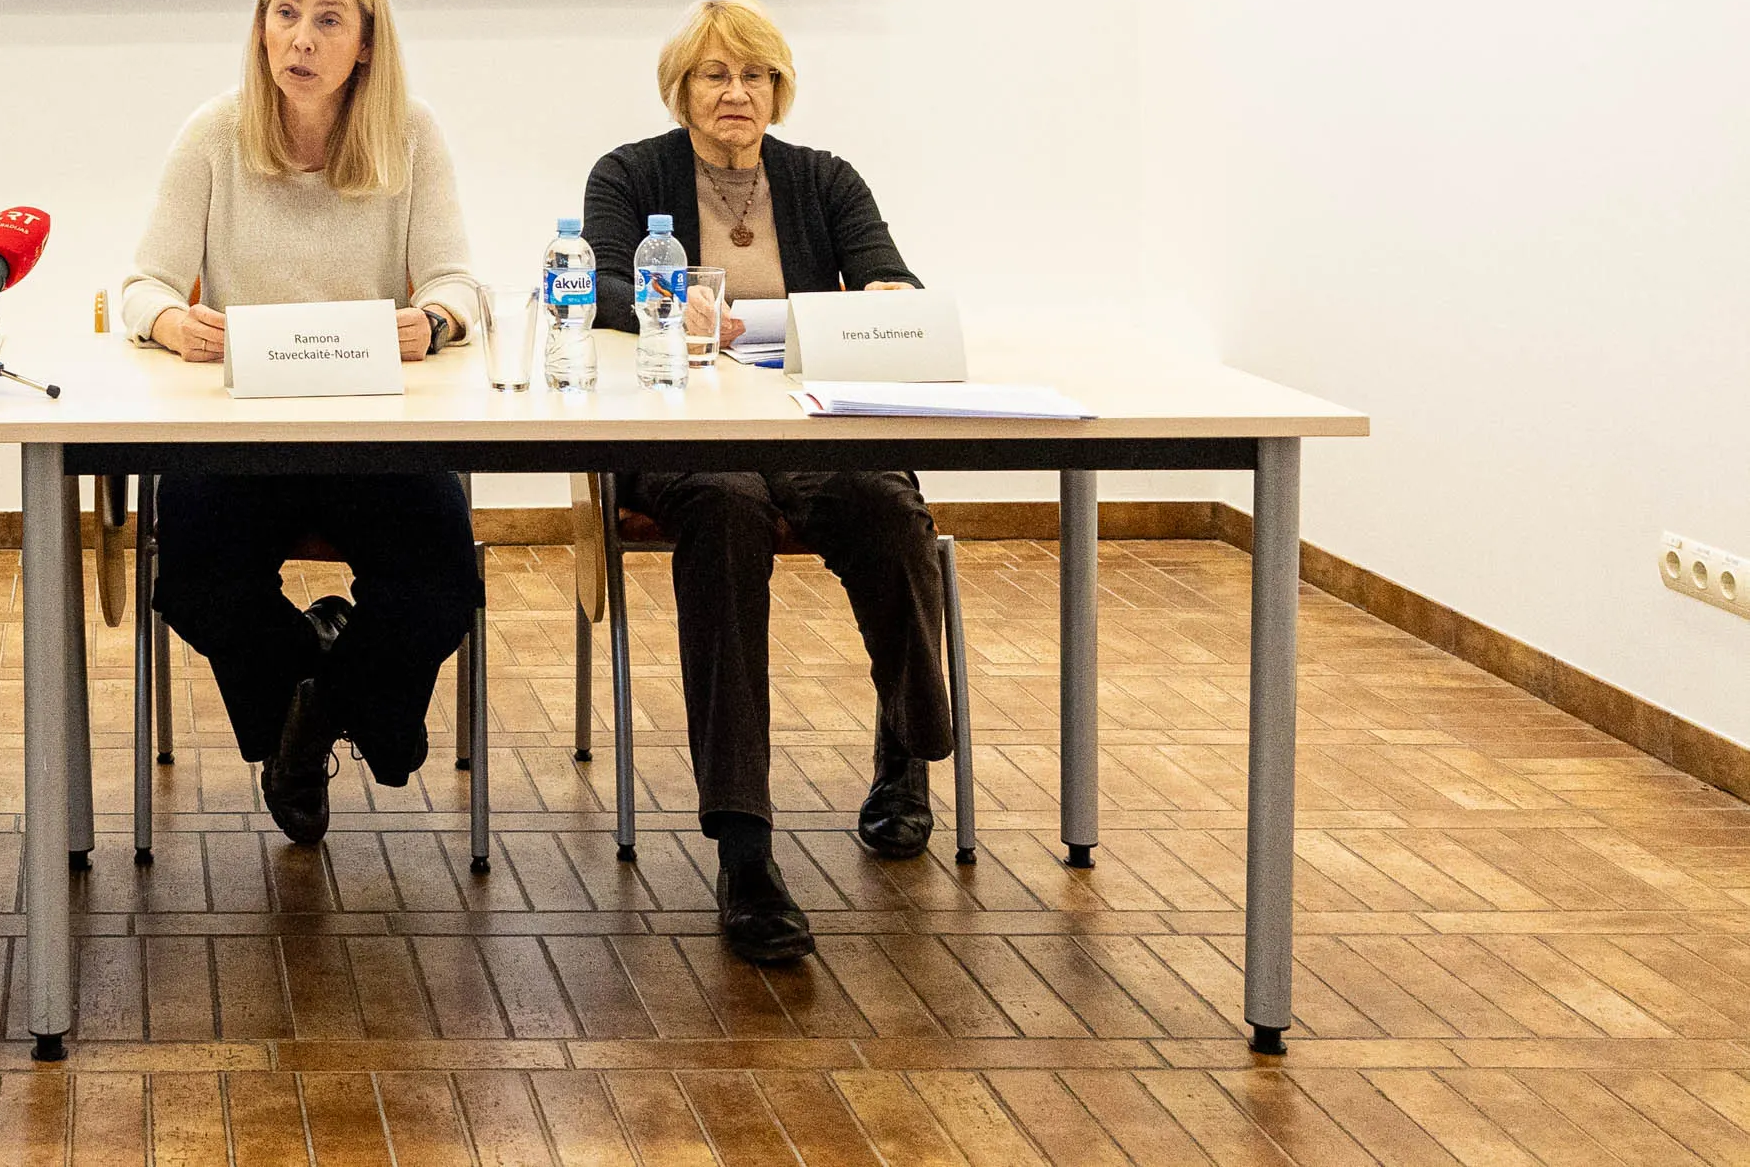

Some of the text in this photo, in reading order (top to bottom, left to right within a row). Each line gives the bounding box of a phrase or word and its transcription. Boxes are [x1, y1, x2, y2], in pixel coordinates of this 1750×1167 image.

[555, 275, 591, 290] akvilė
[294, 333, 340, 344] Ramona
[842, 327, 924, 340] Irena Šutinienė
[268, 348, 370, 361] Staveckaitė-Notari
